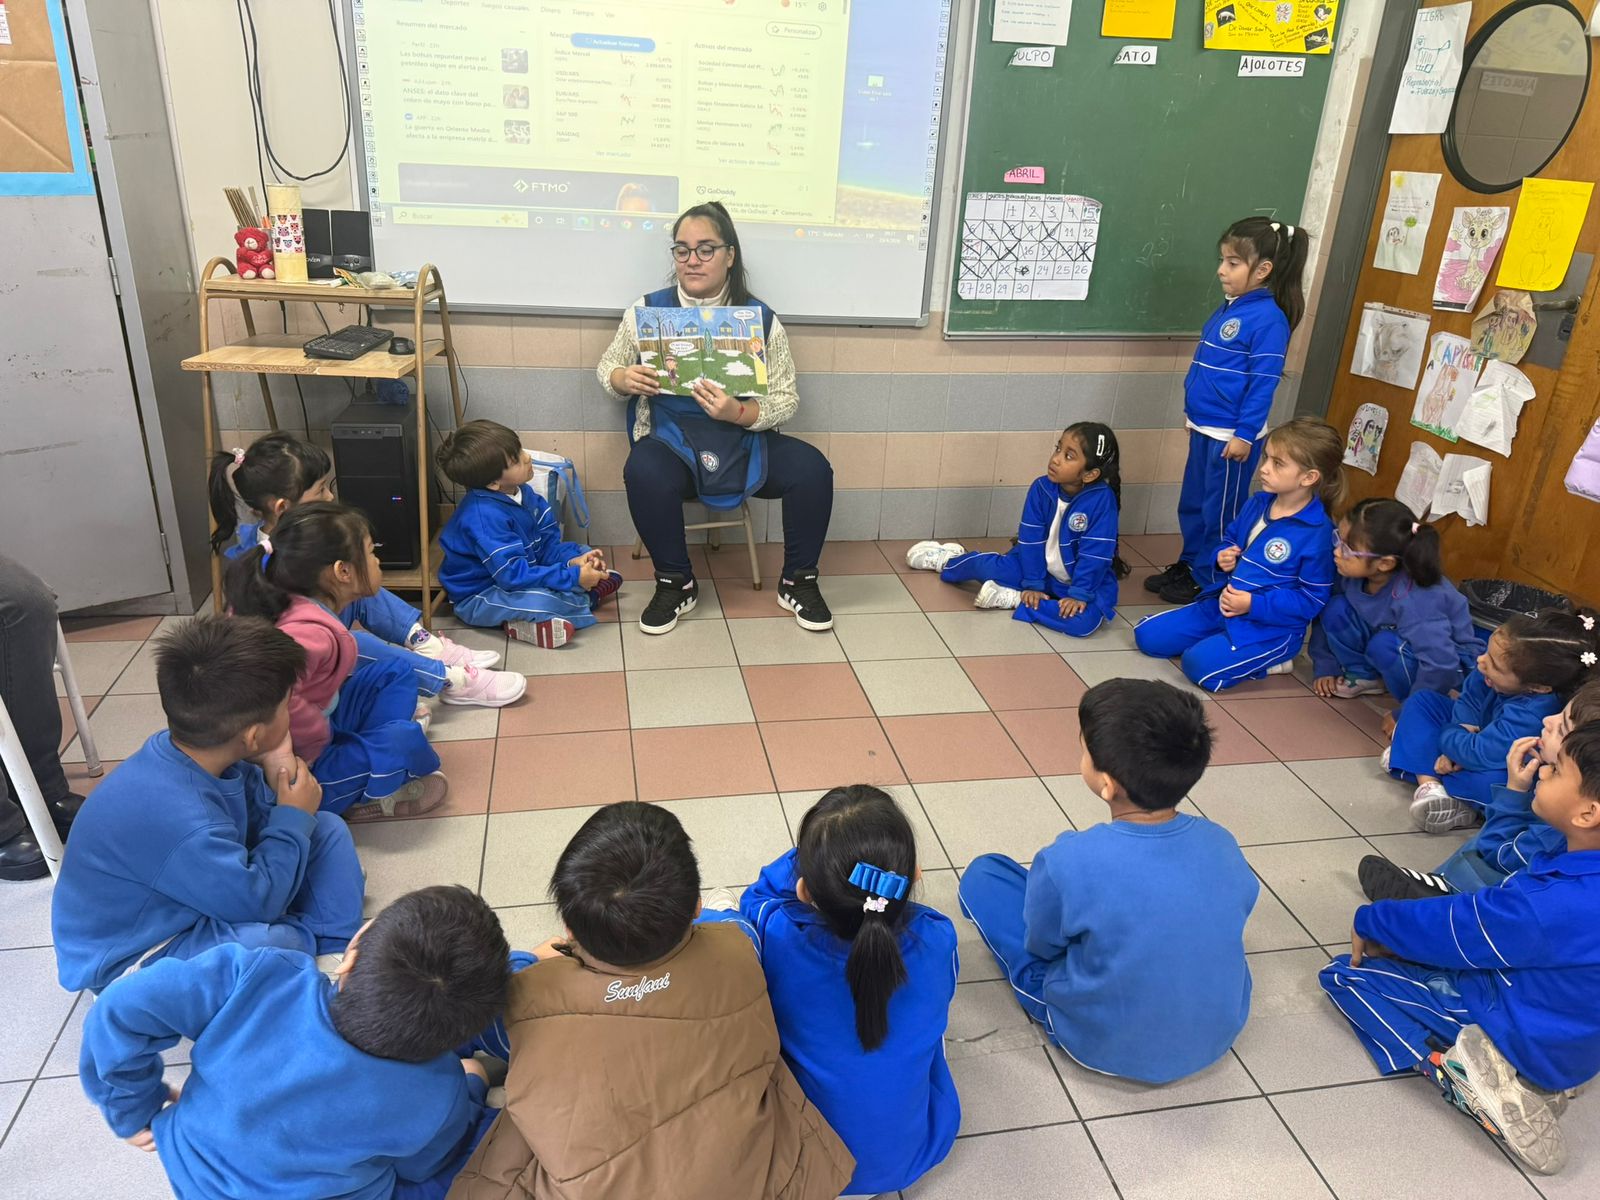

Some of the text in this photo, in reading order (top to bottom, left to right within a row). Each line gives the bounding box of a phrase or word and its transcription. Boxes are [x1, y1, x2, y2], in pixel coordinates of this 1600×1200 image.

[1418, 10, 1446, 22] TIGRE
[396, 19, 427, 28] Resumen
[439, 23, 468, 31] mercado
[784, 26, 817, 36] Personalizar
[727, 45, 753, 53] mercado
[1240, 57, 1304, 73] AJOLOTES
[1009, 168, 1041, 179] ABRIL
[532, 182, 568, 193] FTMO
[707, 187, 737, 197] GoDaddy
[1029, 205, 1037, 218] 2
[1049, 205, 1057, 218] 3
[1088, 207, 1097, 219] 5
[1064, 227, 1075, 237] 11
[1083, 228, 1094, 238] 12
[1024, 246, 1034, 256] 16
[1036, 264, 1049, 276] 24
[1056, 264, 1071, 275] 25
[1074, 264, 1089, 275] 26
[959, 282, 1030, 295] 27 28 29 30
[604, 972, 670, 1003] Sunfani
